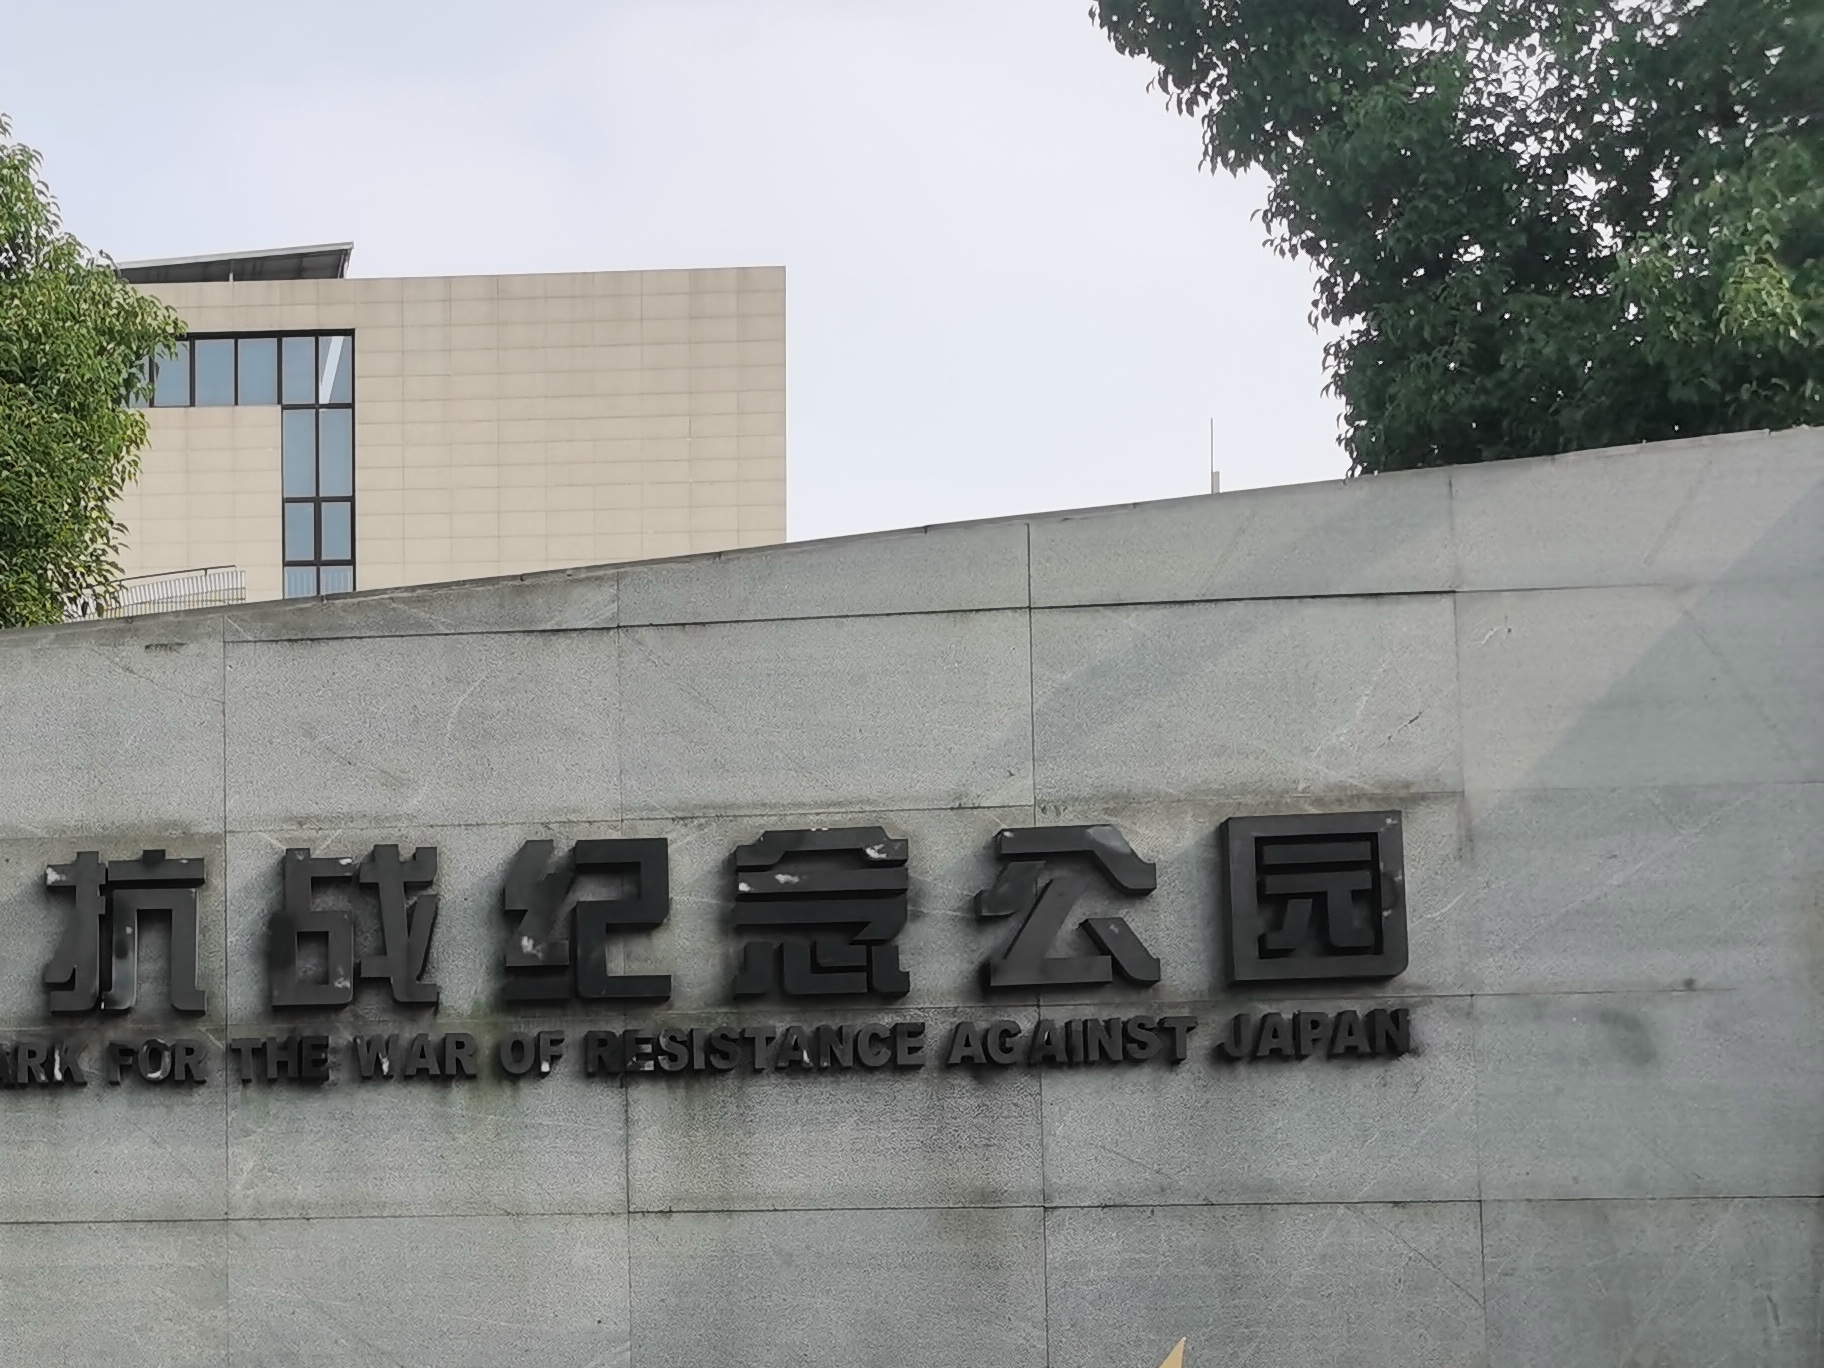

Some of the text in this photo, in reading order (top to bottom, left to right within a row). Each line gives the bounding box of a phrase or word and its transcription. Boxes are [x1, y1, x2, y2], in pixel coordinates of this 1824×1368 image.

[108, 1037, 207, 1084] FOR
[230, 1035, 331, 1083] THE
[354, 1032, 477, 1080] WAR
[499, 1030, 565, 1076] OF
[584, 1022, 925, 1075] RESISTANCE
[947, 1015, 1198, 1066] AGAINST
[1219, 1008, 1411, 1060] JAPAN
